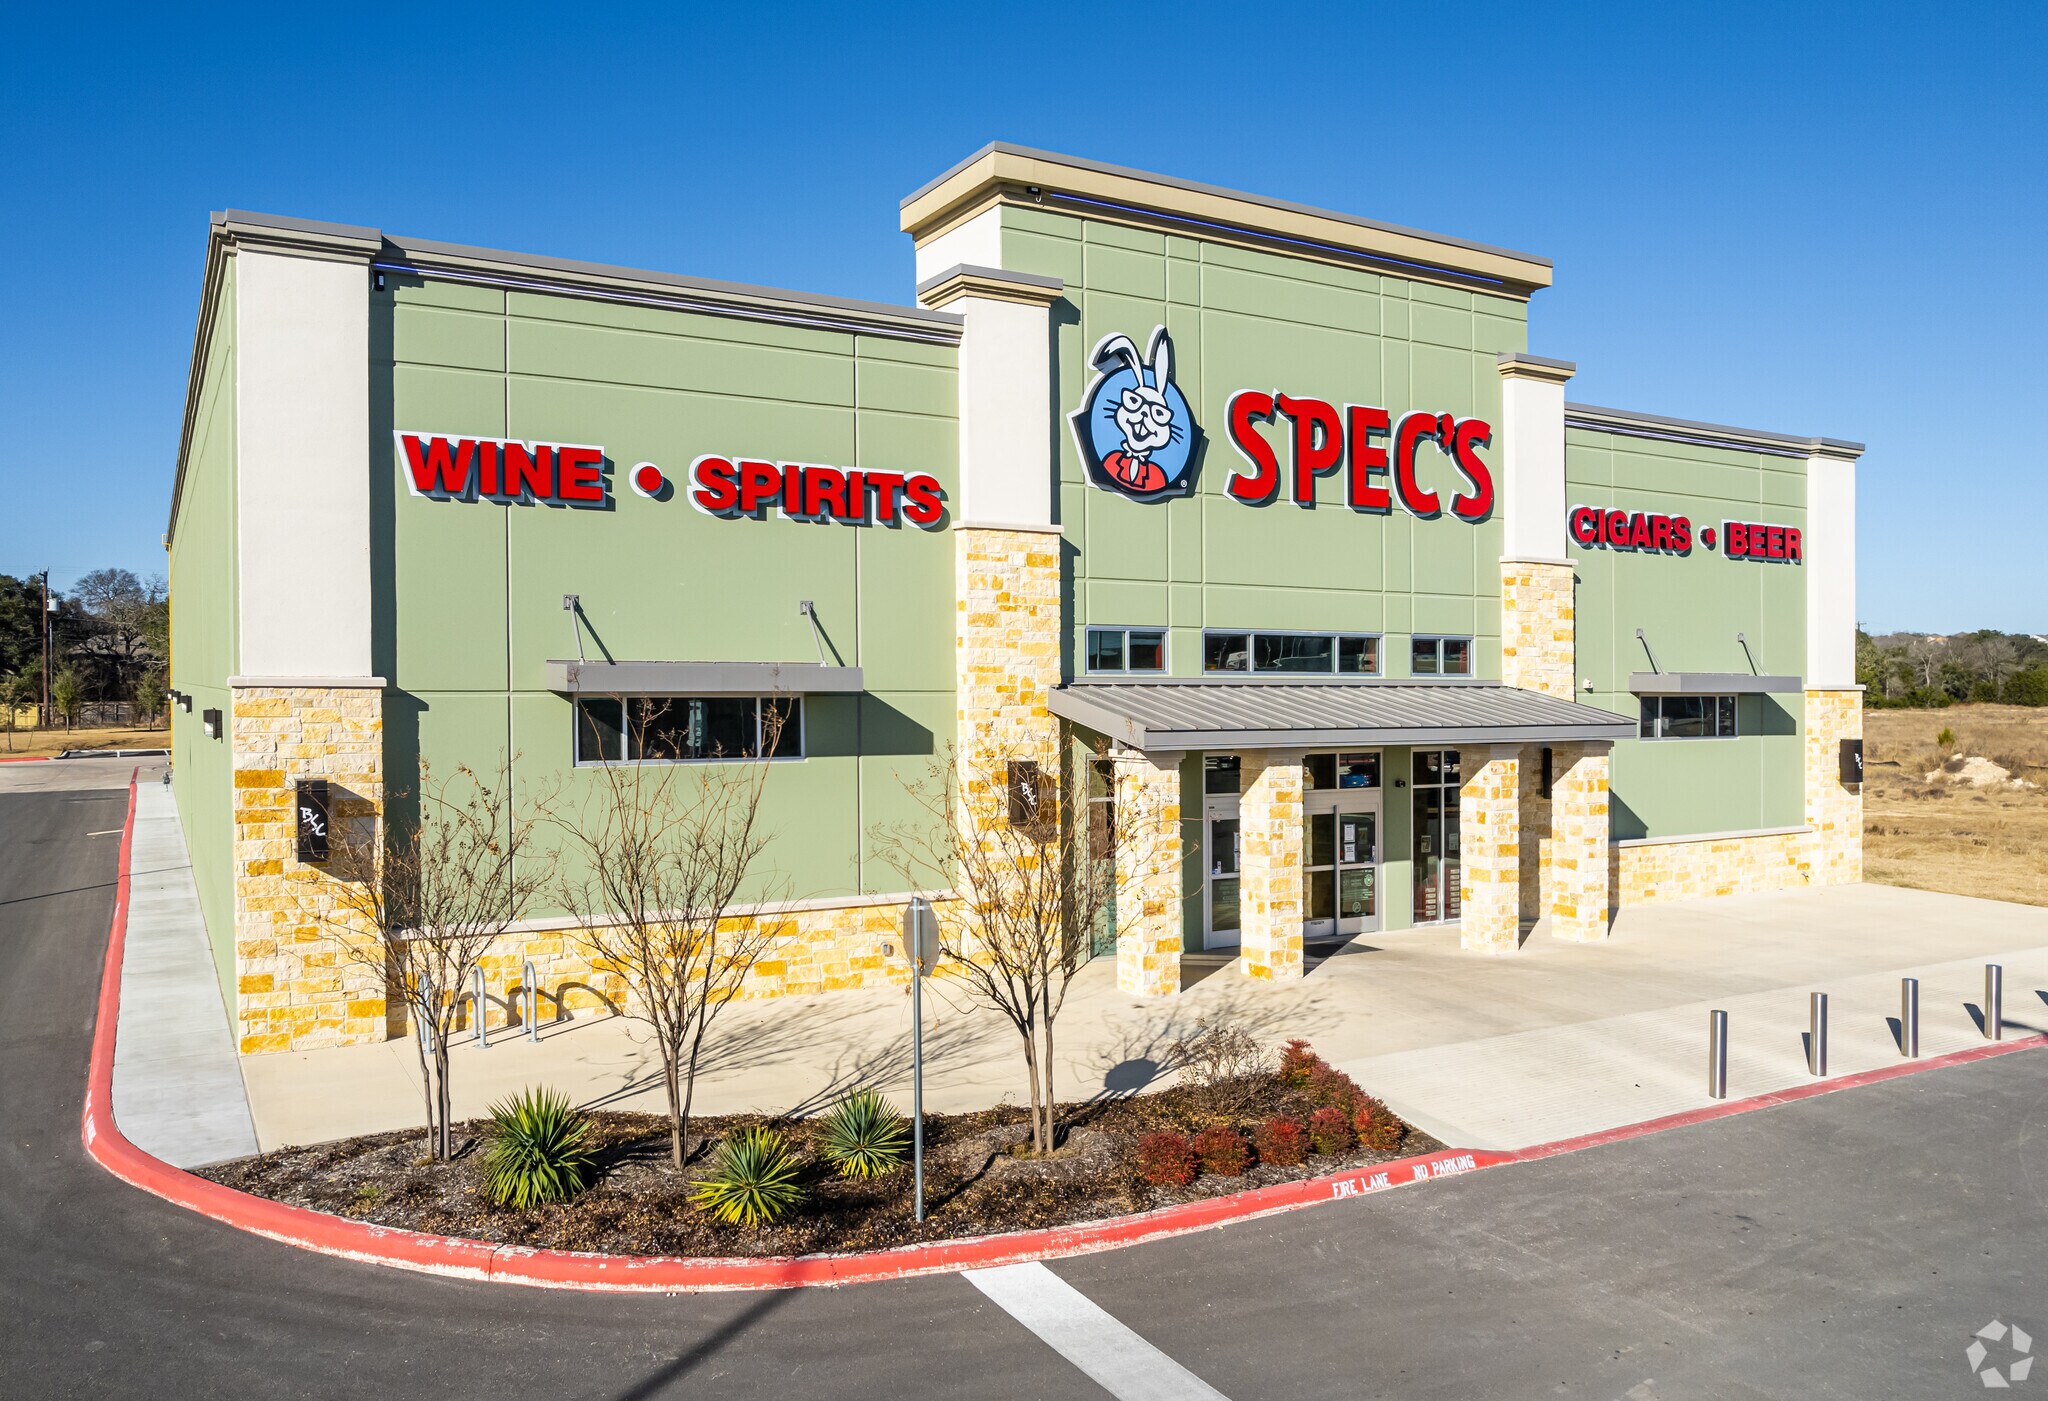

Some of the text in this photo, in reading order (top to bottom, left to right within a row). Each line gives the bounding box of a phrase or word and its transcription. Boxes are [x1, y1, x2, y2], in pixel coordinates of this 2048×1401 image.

[399, 433, 944, 525] WINE SPIRITS
[1230, 390, 1495, 518] SPEC'S
[1573, 505, 1803, 560] CIGARS BEER
[1332, 1172, 1391, 1199] FIRE LANE
[1412, 1154, 1475, 1180] NO PARKING
